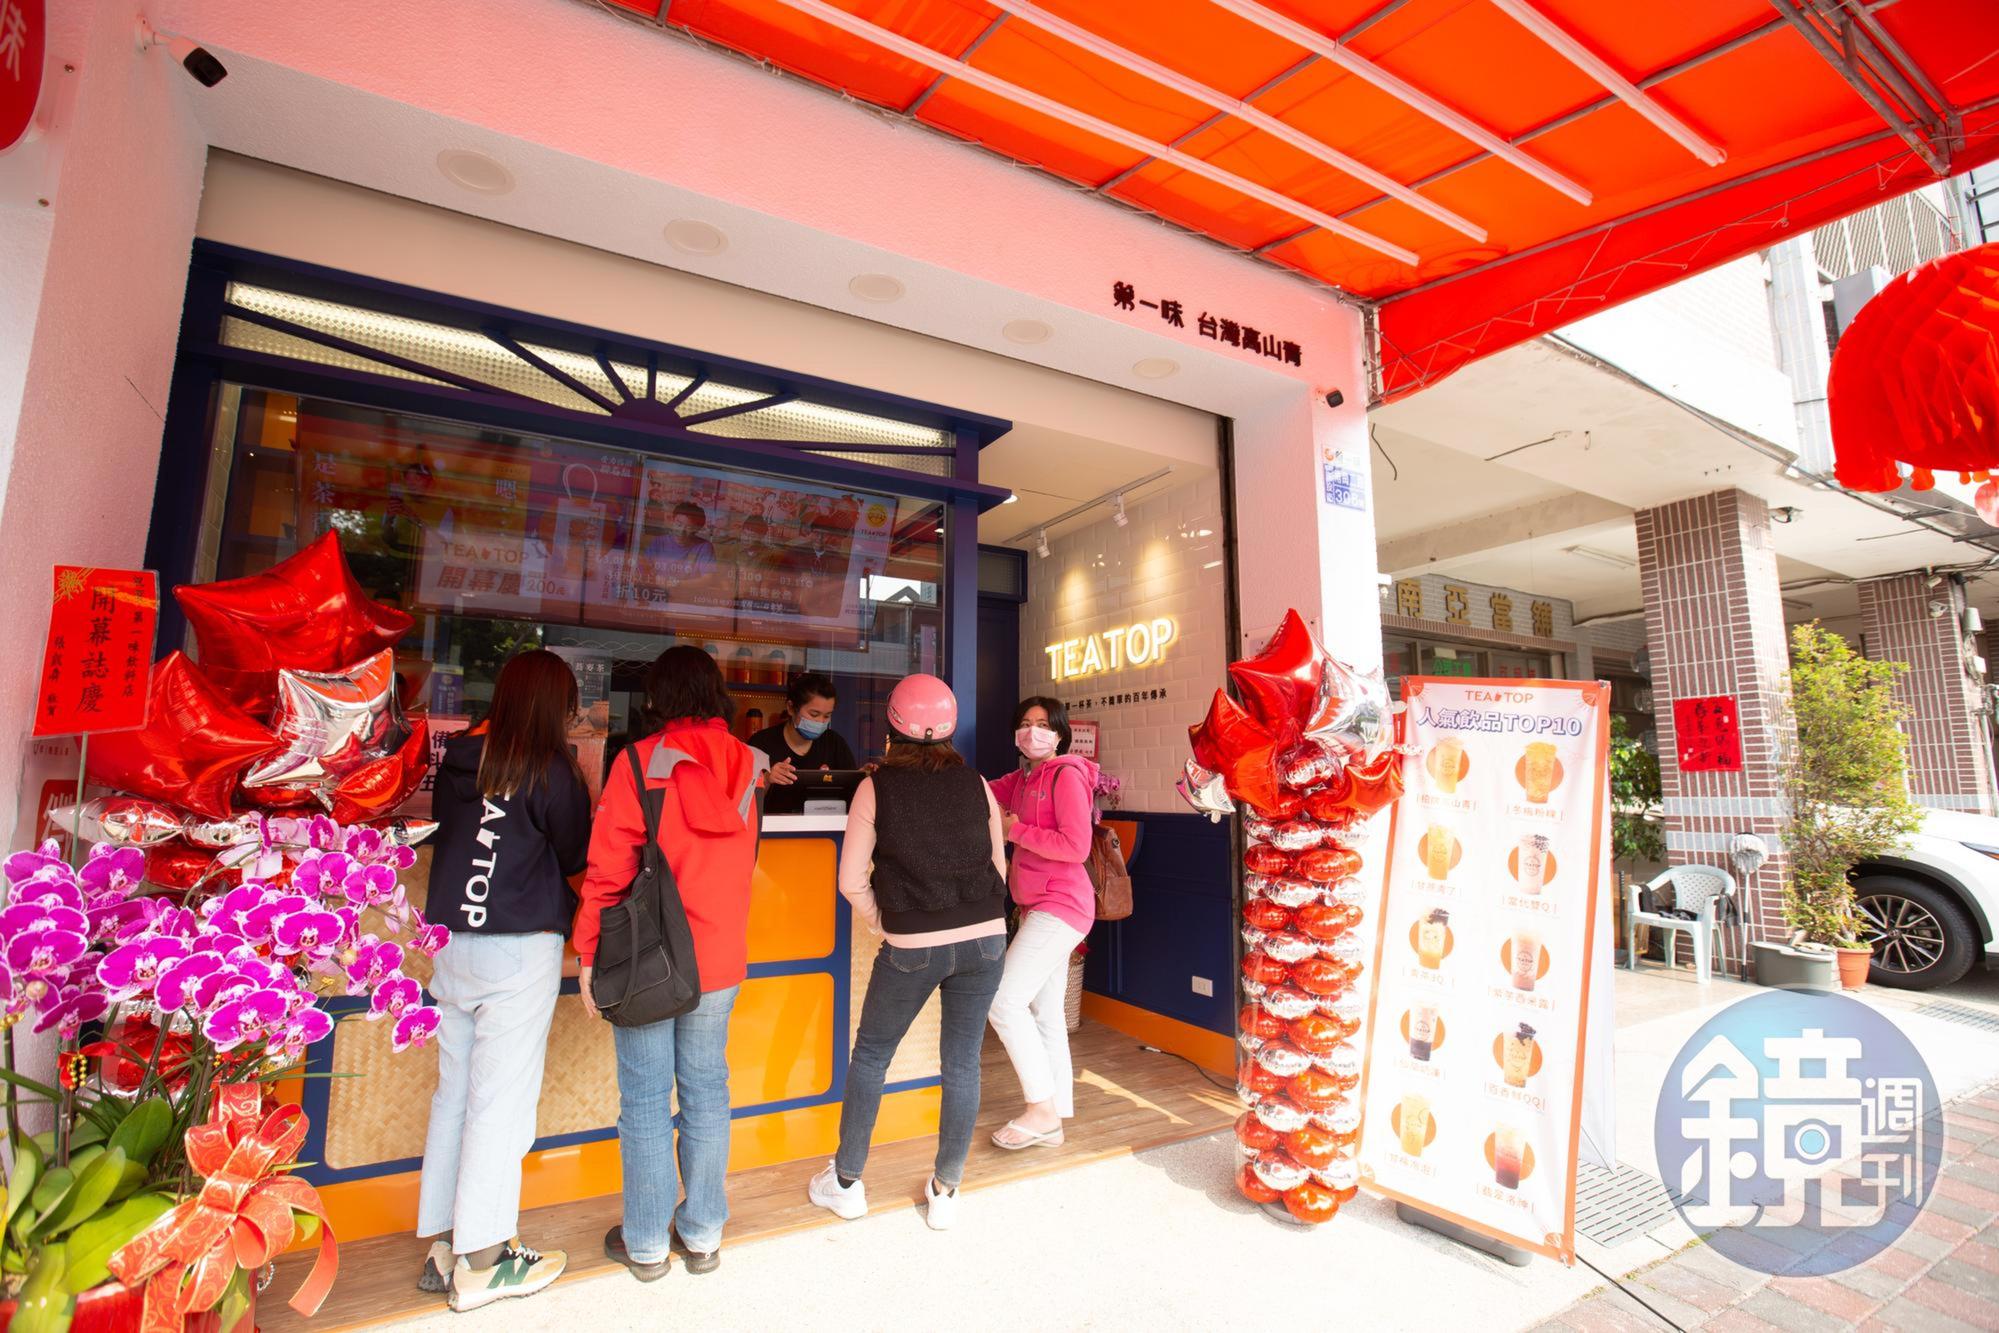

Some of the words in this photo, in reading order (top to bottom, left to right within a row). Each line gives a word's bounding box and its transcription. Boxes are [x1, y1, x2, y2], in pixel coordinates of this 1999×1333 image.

[75, 584, 116, 714] 開幕誌慶
[1044, 617, 1176, 680] TEATOP
[1416, 706, 1583, 737] 人氣飲品TOP10
